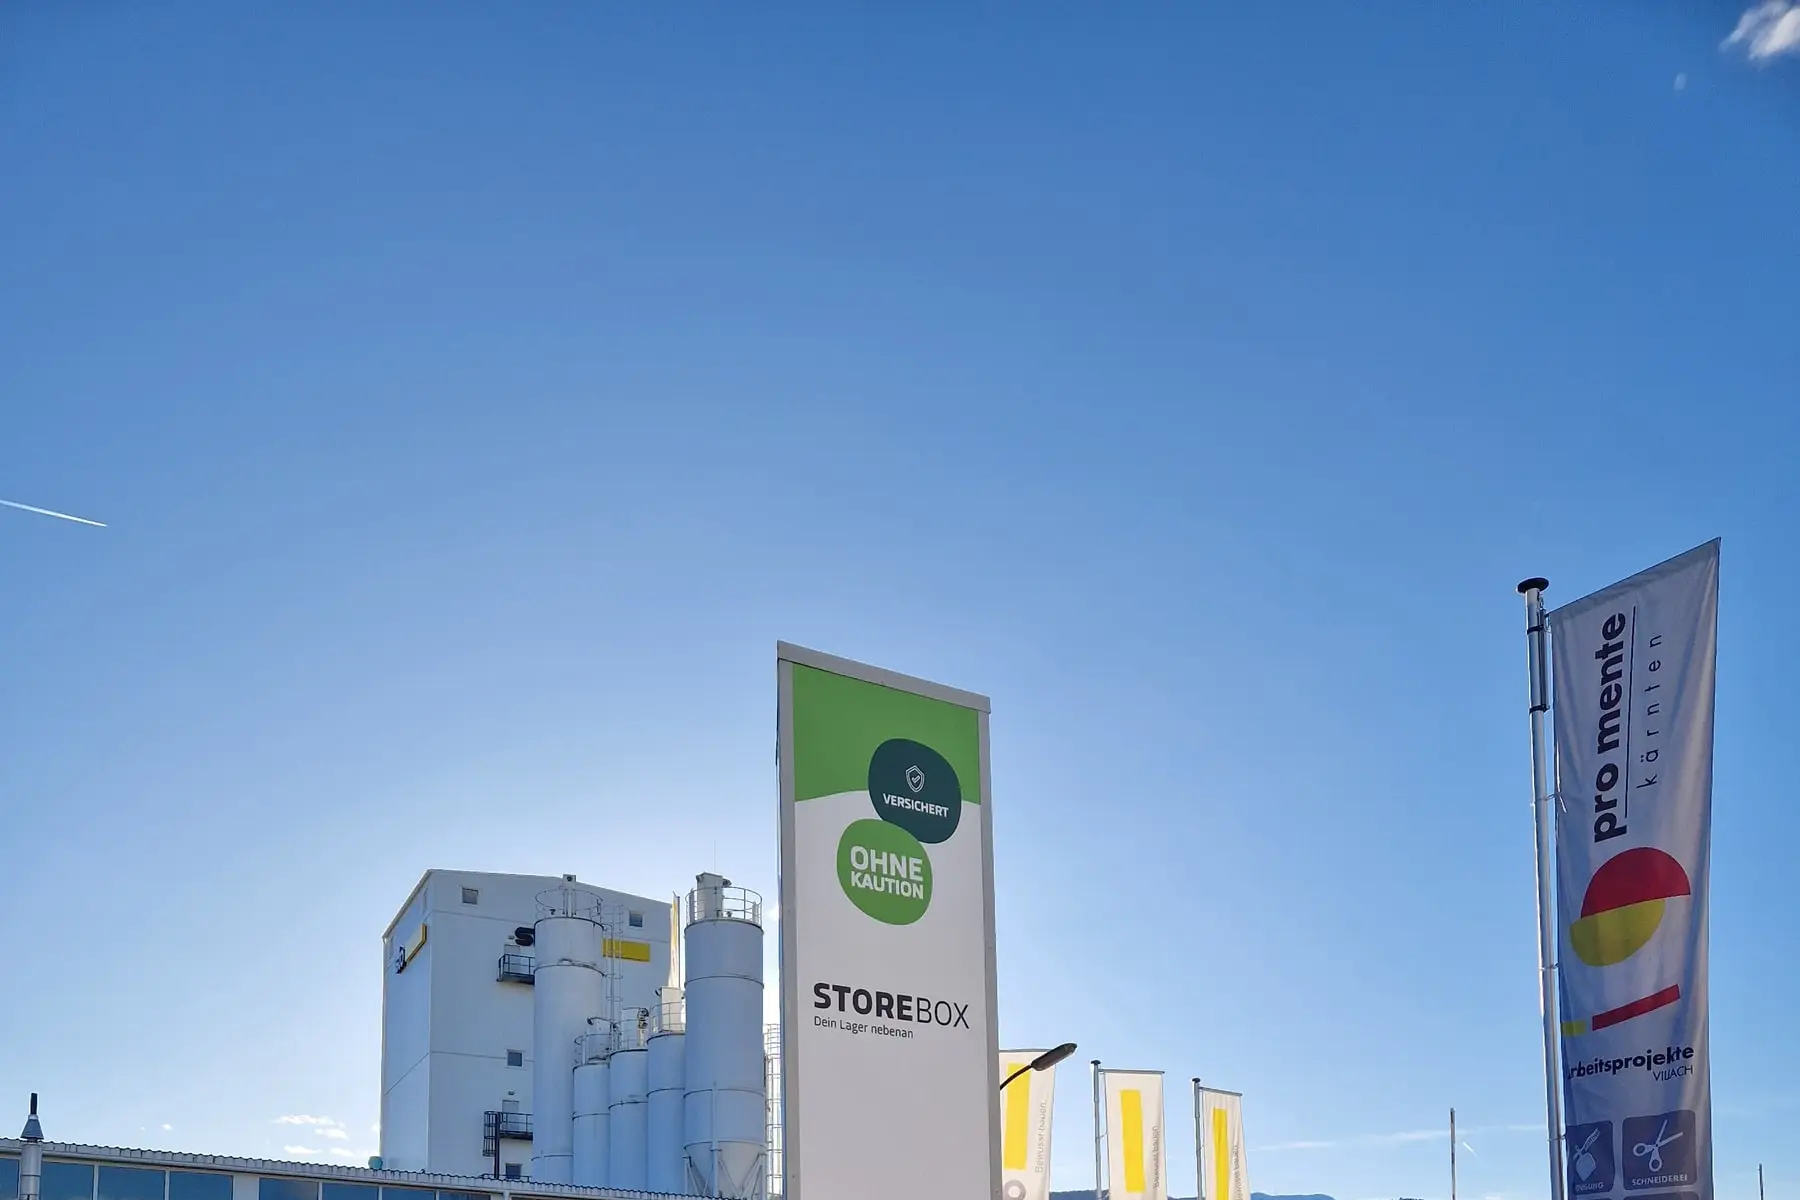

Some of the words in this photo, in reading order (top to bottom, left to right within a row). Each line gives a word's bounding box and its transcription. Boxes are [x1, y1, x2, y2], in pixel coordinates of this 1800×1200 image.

[1595, 611, 1626, 755] mente
[1636, 634, 1662, 789] kärnten
[883, 793, 949, 817] VERSICHERT
[1594, 763, 1628, 843] pro
[850, 845, 924, 882] OHNE
[851, 870, 924, 899] KAUTION
[813, 982, 970, 1030] STOREBOX
[814, 1015, 837, 1029] Dein
[840, 1020, 869, 1035] Lager
[871, 1024, 914, 1039] nebenan
[1652, 1064, 1693, 1082] VILLACH
[1632, 1173, 1688, 1187] SCHNEIDEREI
